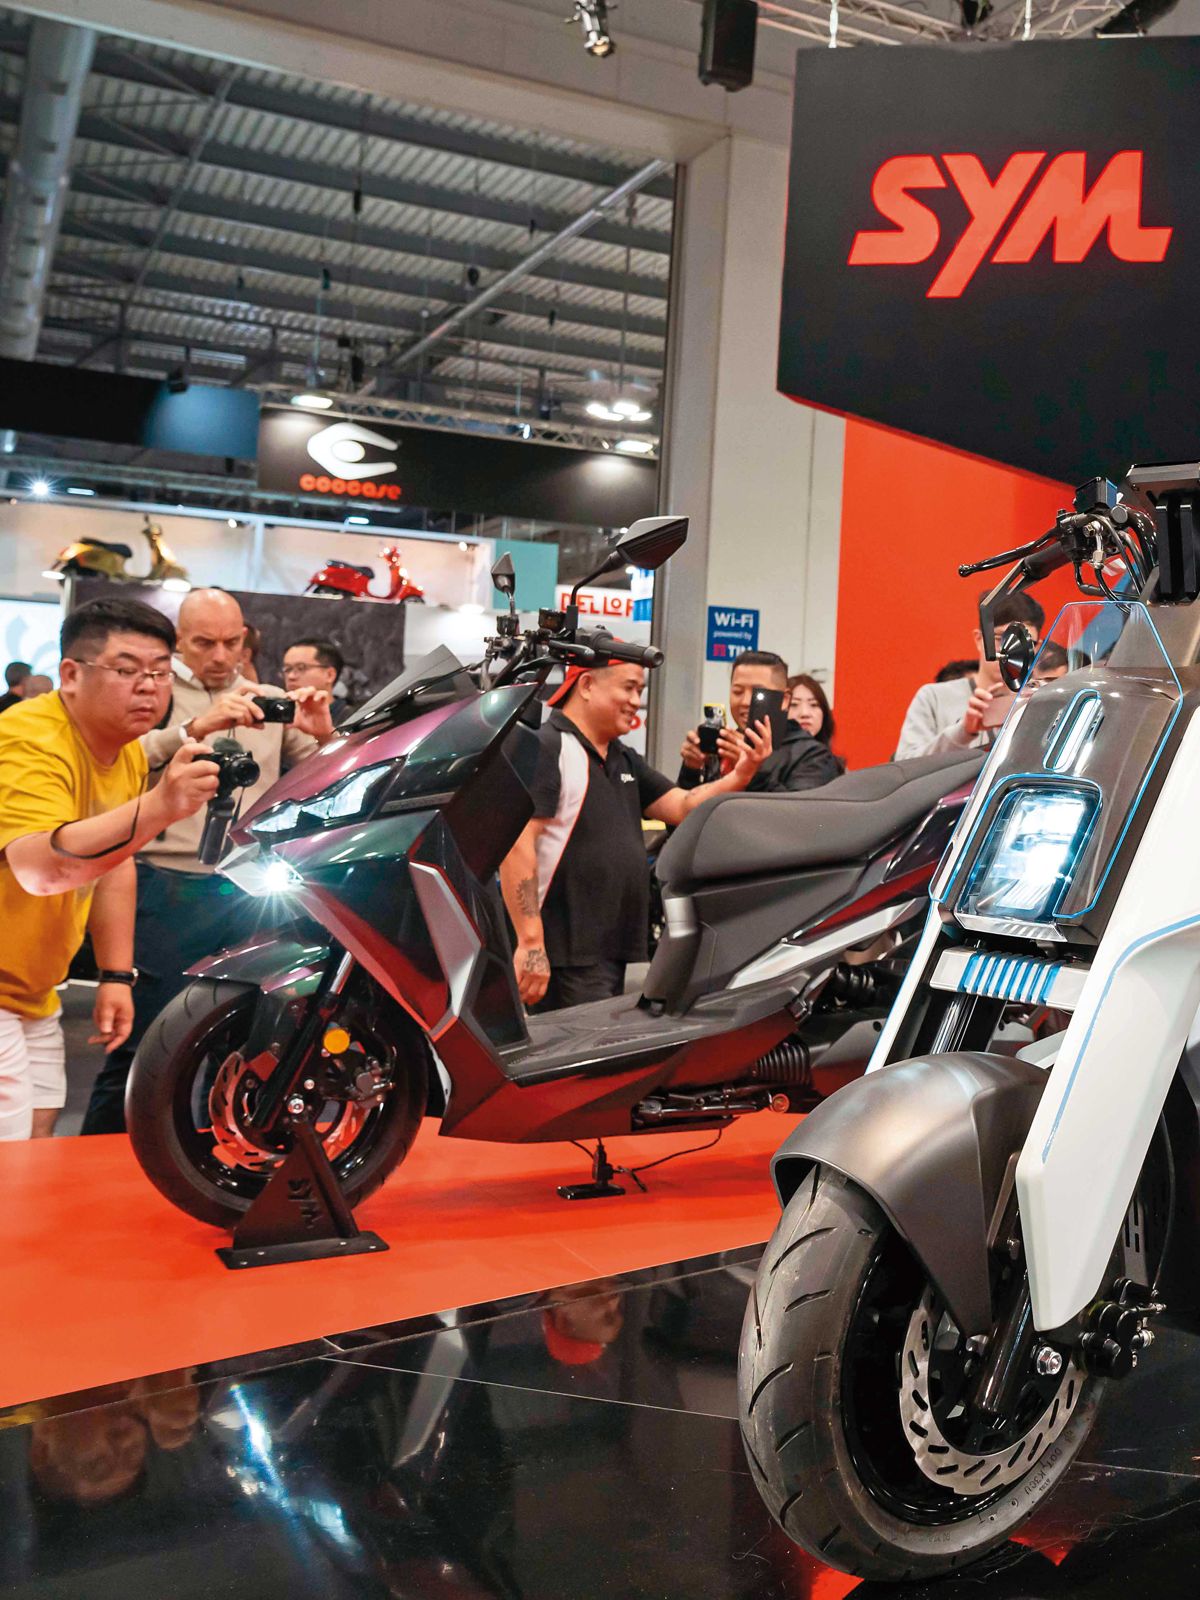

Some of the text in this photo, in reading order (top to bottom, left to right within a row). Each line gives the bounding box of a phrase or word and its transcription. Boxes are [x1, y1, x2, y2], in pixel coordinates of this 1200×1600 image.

[847, 150, 1174, 298] SYM
[300, 473, 401, 500] coocase
[714, 612, 754, 628] Wi-Fi
